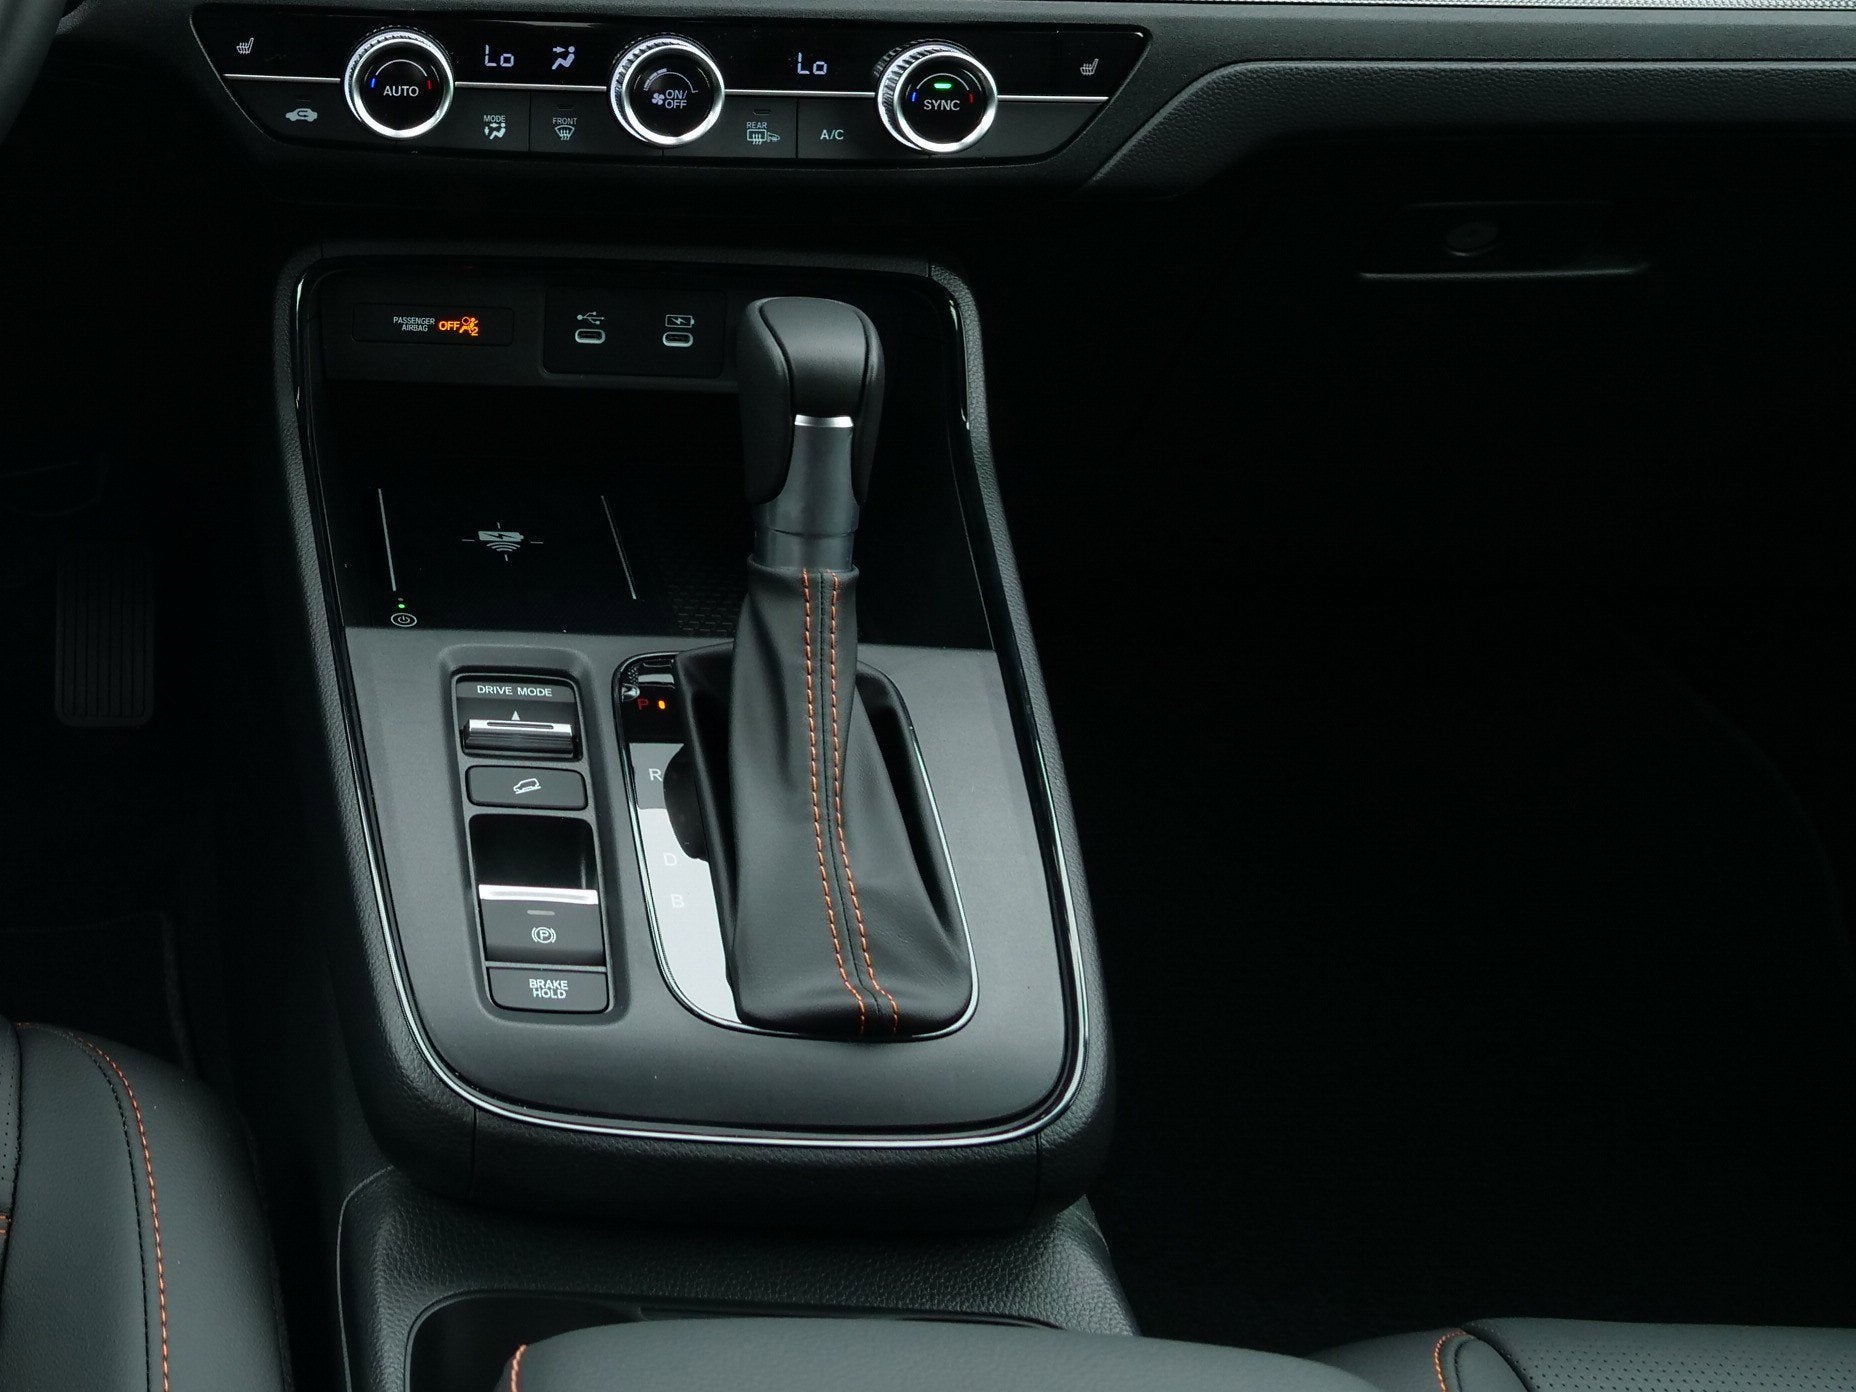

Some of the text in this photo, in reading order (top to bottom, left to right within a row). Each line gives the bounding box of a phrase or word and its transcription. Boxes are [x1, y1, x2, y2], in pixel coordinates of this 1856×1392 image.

[383, 85, 420, 98] AUTO
[664, 99, 687, 110] OFF
[923, 98, 961, 113] SYNC
[483, 114, 506, 124] MODE
[552, 117, 578, 126] FRONT
[746, 121, 768, 130] REAR
[820, 128, 845, 142] A/C
[392, 316, 436, 325] PASSENGER
[438, 321, 461, 331] OFF
[401, 324, 429, 332] AIRBAG
[476, 684, 552, 697] DRIVE MODE
[648, 767, 663, 782] R
[663, 852, 679, 867] D
[670, 894, 686, 909] B
[528, 978, 569, 990] BRAKE
[532, 988, 567, 999] HOLD
